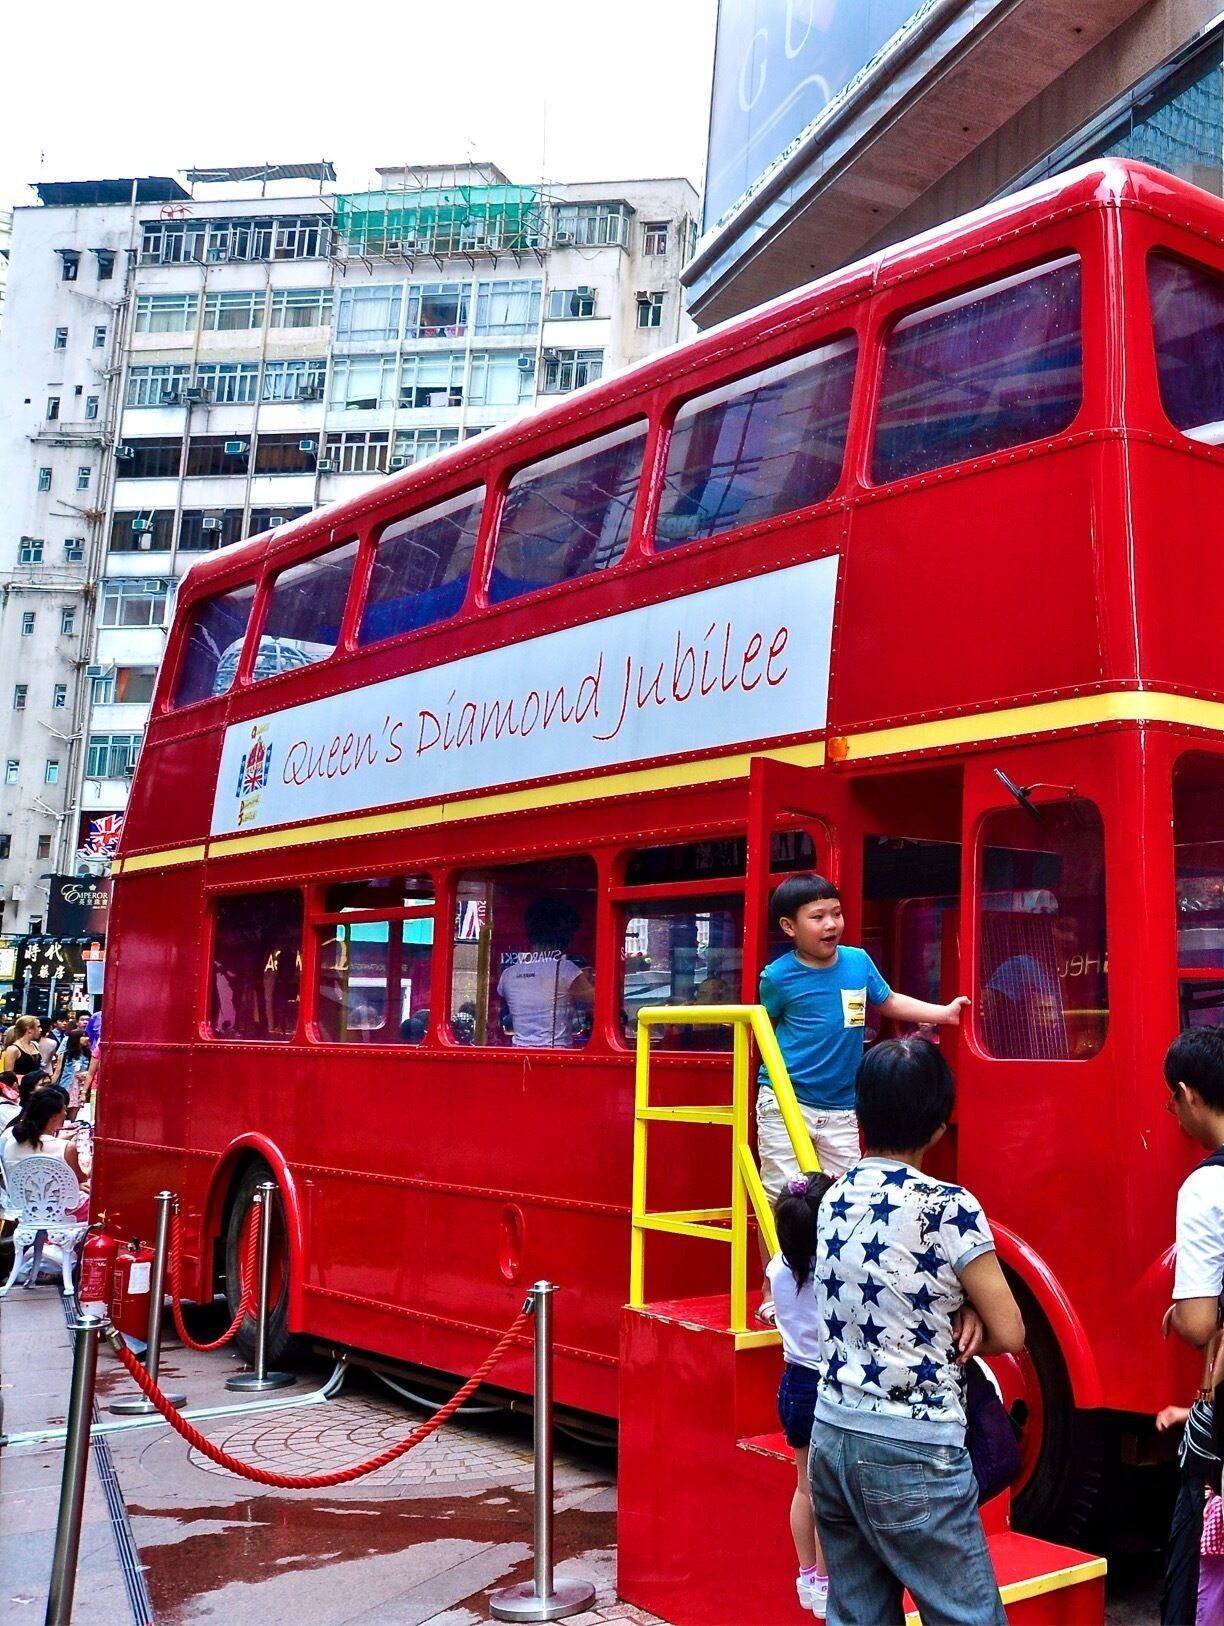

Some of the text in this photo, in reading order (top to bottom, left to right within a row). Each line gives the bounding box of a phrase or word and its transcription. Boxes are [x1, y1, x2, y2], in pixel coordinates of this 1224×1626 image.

[283, 622, 790, 786] Queen's Diamond Jubilee
[61, 883, 109, 904] EMPEROR
[24, 941, 64, 962] 時代
